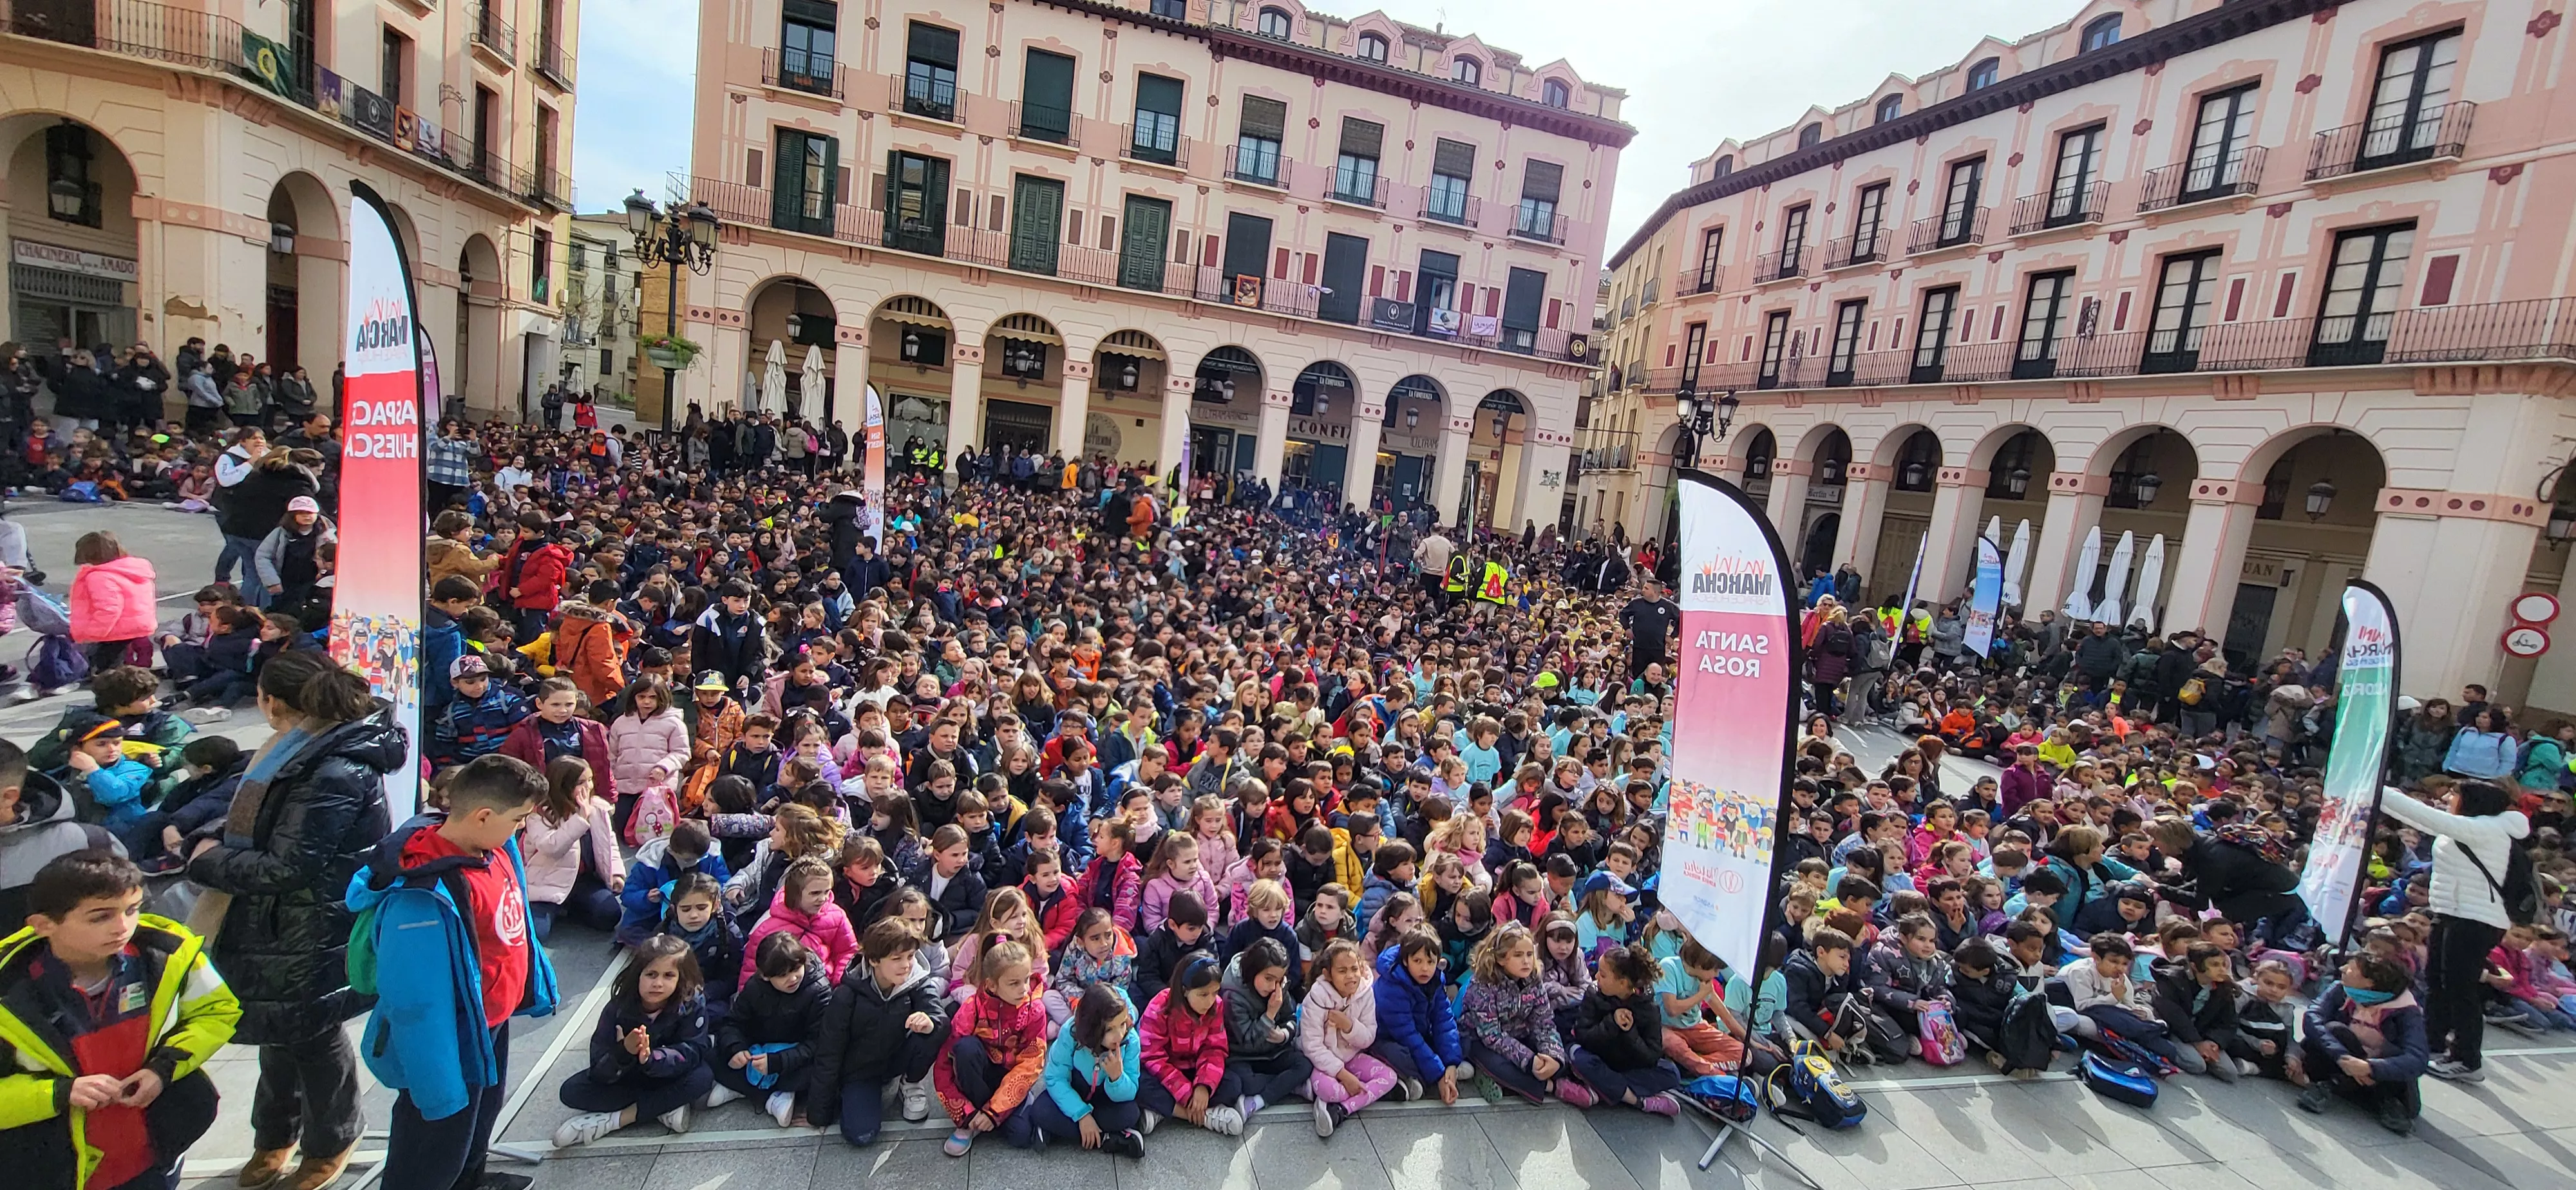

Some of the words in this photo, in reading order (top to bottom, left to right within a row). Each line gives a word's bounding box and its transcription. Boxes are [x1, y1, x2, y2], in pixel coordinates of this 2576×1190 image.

[100, 258, 135, 274] AMADO
[1320, 376, 1325, 384] LA
[1325, 377, 1345, 387] CONFIANZA
[1408, 389, 1414, 397] LA
[1414, 391, 1432, 400] CONFIANZA
[1411, 436, 1439, 449] ULTRAM
[2243, 560, 2275, 577] UAN
